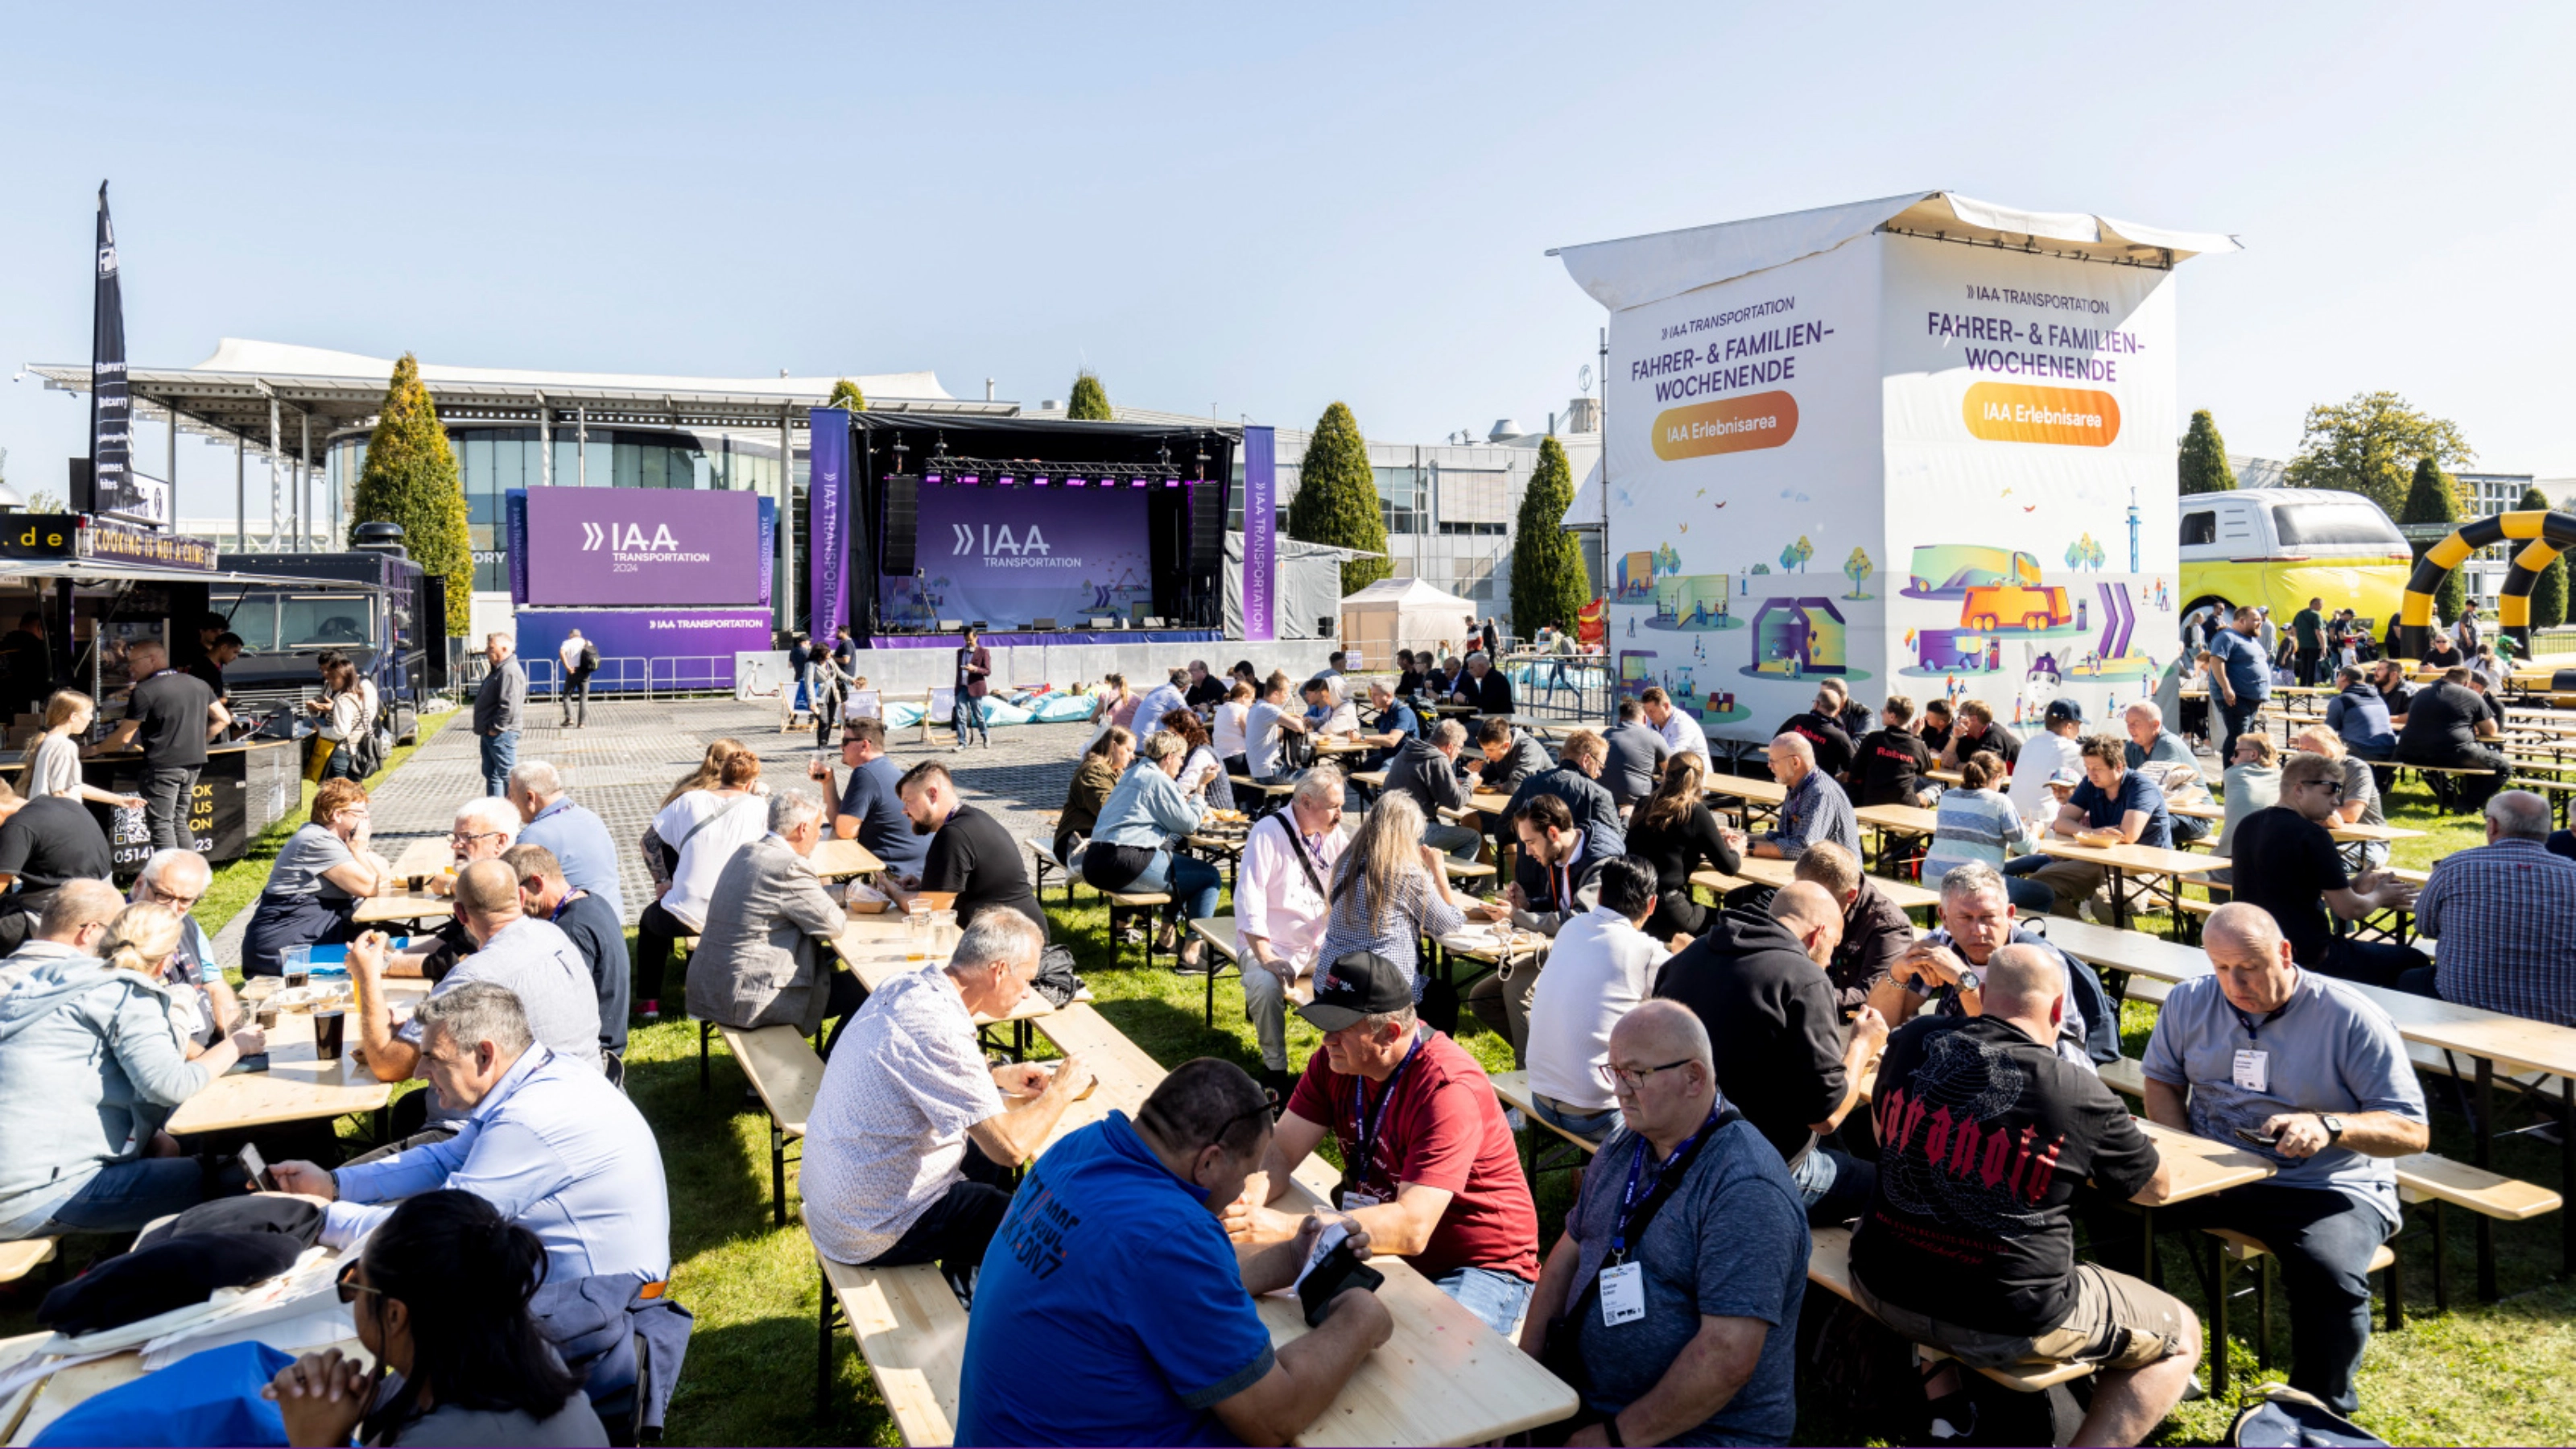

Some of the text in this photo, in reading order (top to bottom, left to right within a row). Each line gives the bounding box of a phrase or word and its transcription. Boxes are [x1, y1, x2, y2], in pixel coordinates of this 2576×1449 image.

[1976, 286, 2110, 314] IAA TRANSPORTATION
[1670, 296, 1795, 339] IAA TRANSPORTATION
[1928, 312, 2145, 354] FAHRER- & FAMILIEN-
[1632, 320, 1835, 382] FAHRER- & FAMILIEN-
[1965, 347, 2116, 382] WOCHENENDE
[1655, 356, 1795, 403] WOCHENENDE
[1984, 402, 2103, 428] IAA Erlebnisarea
[1667, 415, 1777, 443] IAA Erlebnisarea
[95, 528, 204, 563] COOKING IS NOT A CRIME
[612, 522, 679, 551] IAA
[983, 524, 1051, 555] IAA
[472, 551, 506, 564] ORY
[612, 553, 710, 562] TRANSPORTATION
[613, 564, 638, 572] 2024
[824, 485, 837, 642] IAA TRANSPORTATION
[983, 557, 1081, 568] TRANSPORTATION
[1253, 493, 1266, 634] IAA TRANSPORTATION
[658, 620, 763, 629] IAA TRANSPORTATION
[1794, 724, 1827, 745] Raben
[1876, 746, 1914, 764] Raben
[192, 784, 213, 798] OK
[195, 801, 213, 814] US
[188, 817, 213, 831] ON
[195, 838, 213, 851] 23
